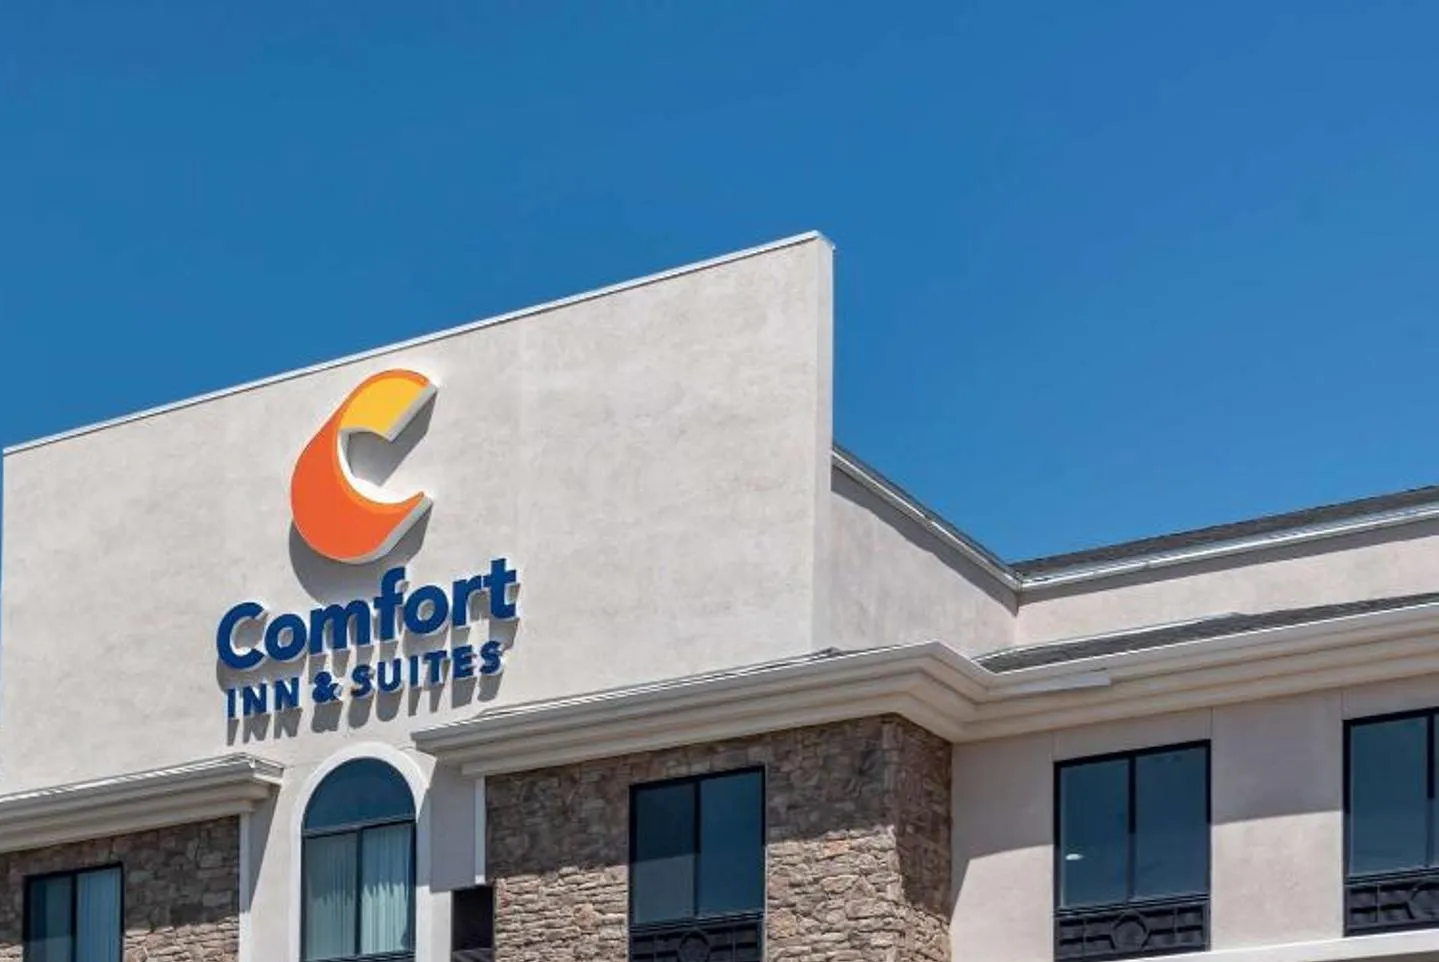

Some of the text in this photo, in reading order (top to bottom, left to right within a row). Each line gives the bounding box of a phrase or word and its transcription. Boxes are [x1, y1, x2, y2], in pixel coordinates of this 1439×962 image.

[216, 558, 517, 670] Comfort
[226, 640, 504, 718] INN & SUITES
